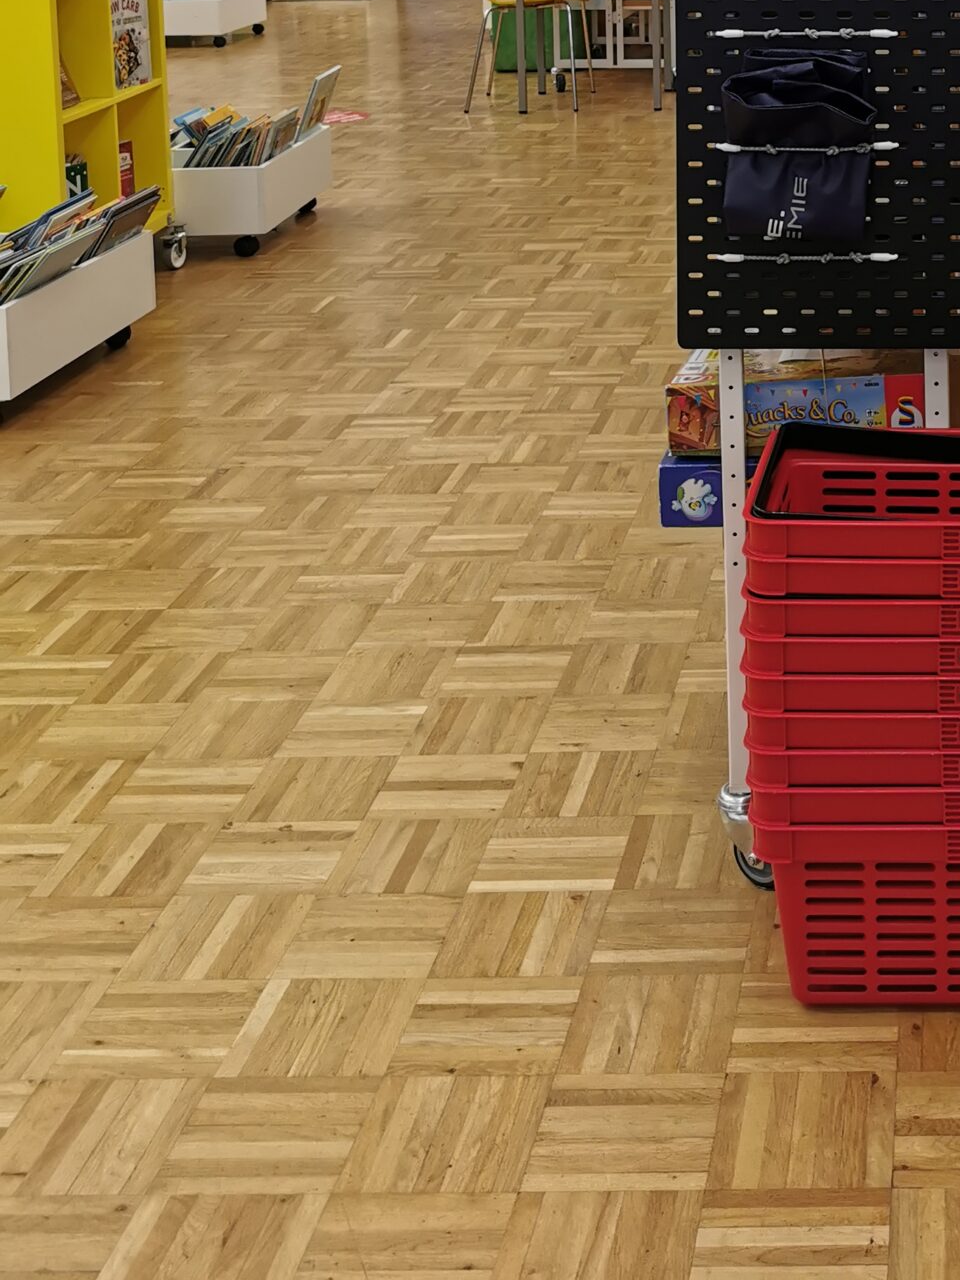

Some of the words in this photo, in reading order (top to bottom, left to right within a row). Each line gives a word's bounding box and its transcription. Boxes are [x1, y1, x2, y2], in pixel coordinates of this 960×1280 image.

[122, 0, 140, 14] CARB
[745, 400, 806, 427] uacks
[809, 398, 826, 420] &
[828, 399, 860, 424] Co.
